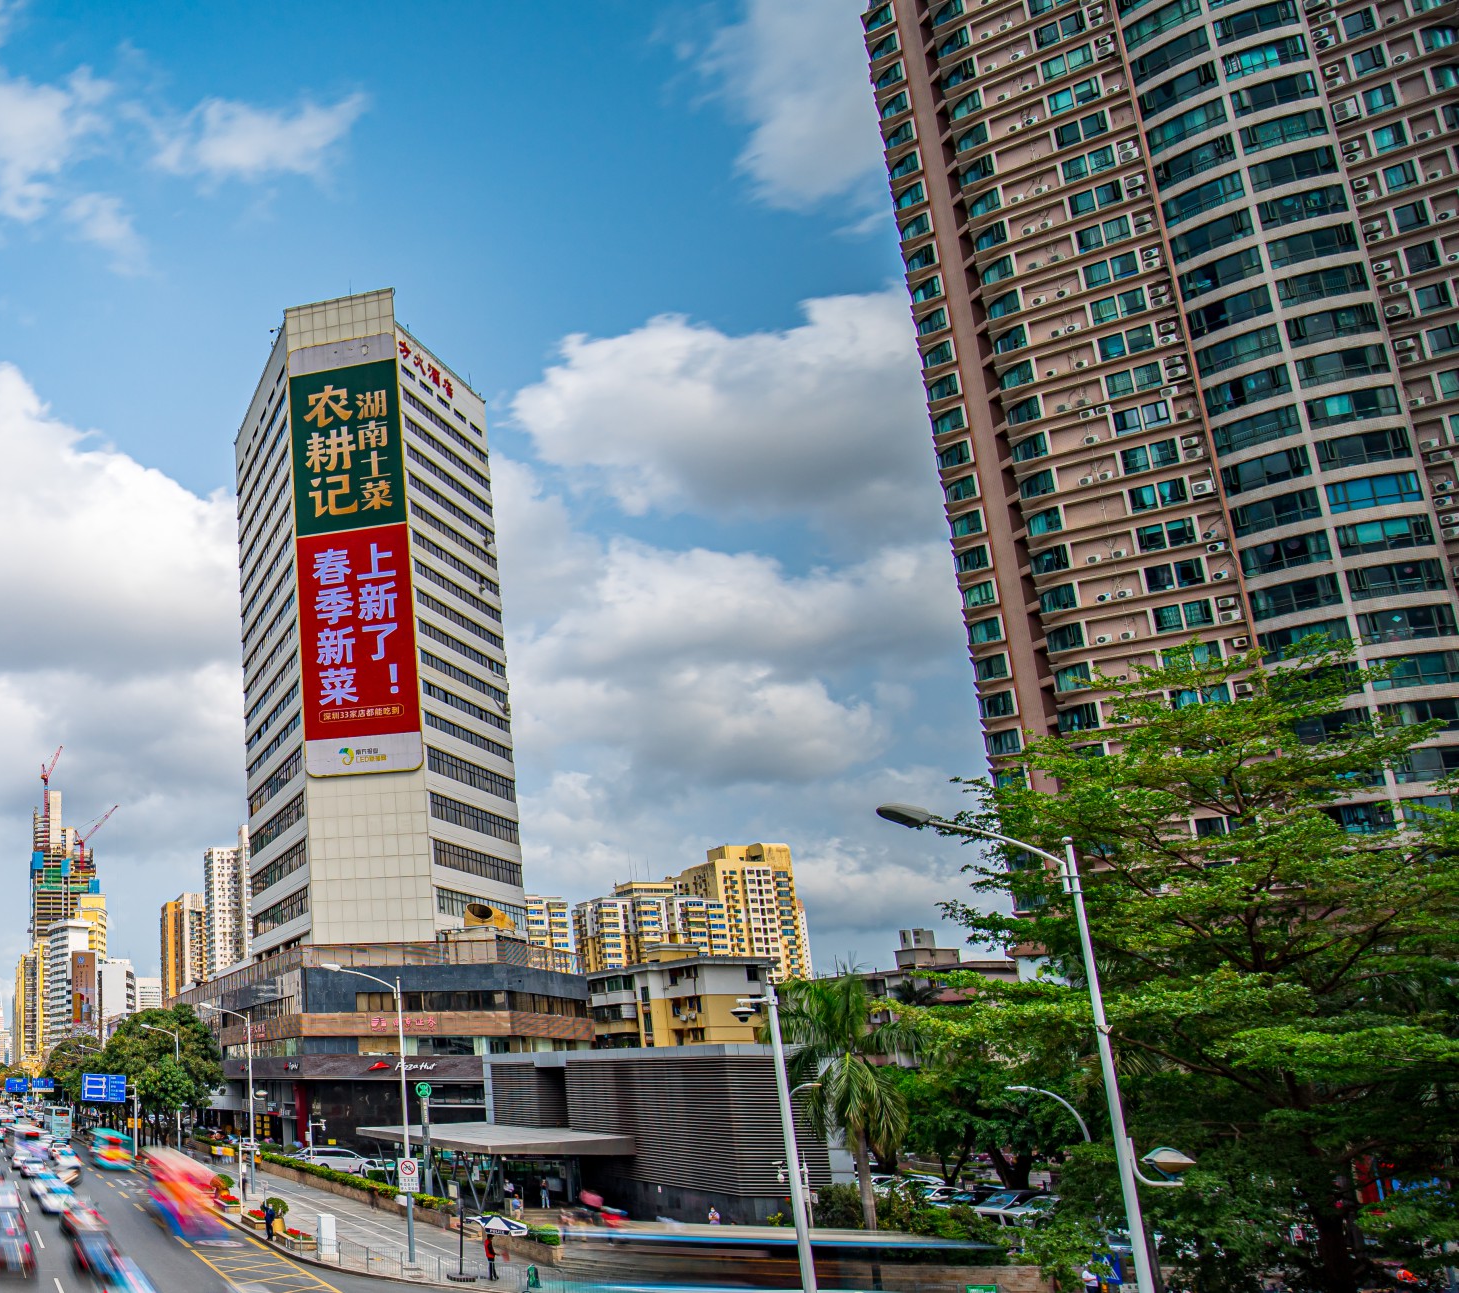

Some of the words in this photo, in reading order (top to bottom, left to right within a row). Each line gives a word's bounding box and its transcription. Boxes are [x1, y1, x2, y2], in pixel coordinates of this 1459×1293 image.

[303, 385, 359, 518] 农耕记
[355, 389, 393, 511] 湖南土菜
[312, 548, 359, 706] 春季新菜
[323, 706, 400, 720] 深圳33家店都能吃到
